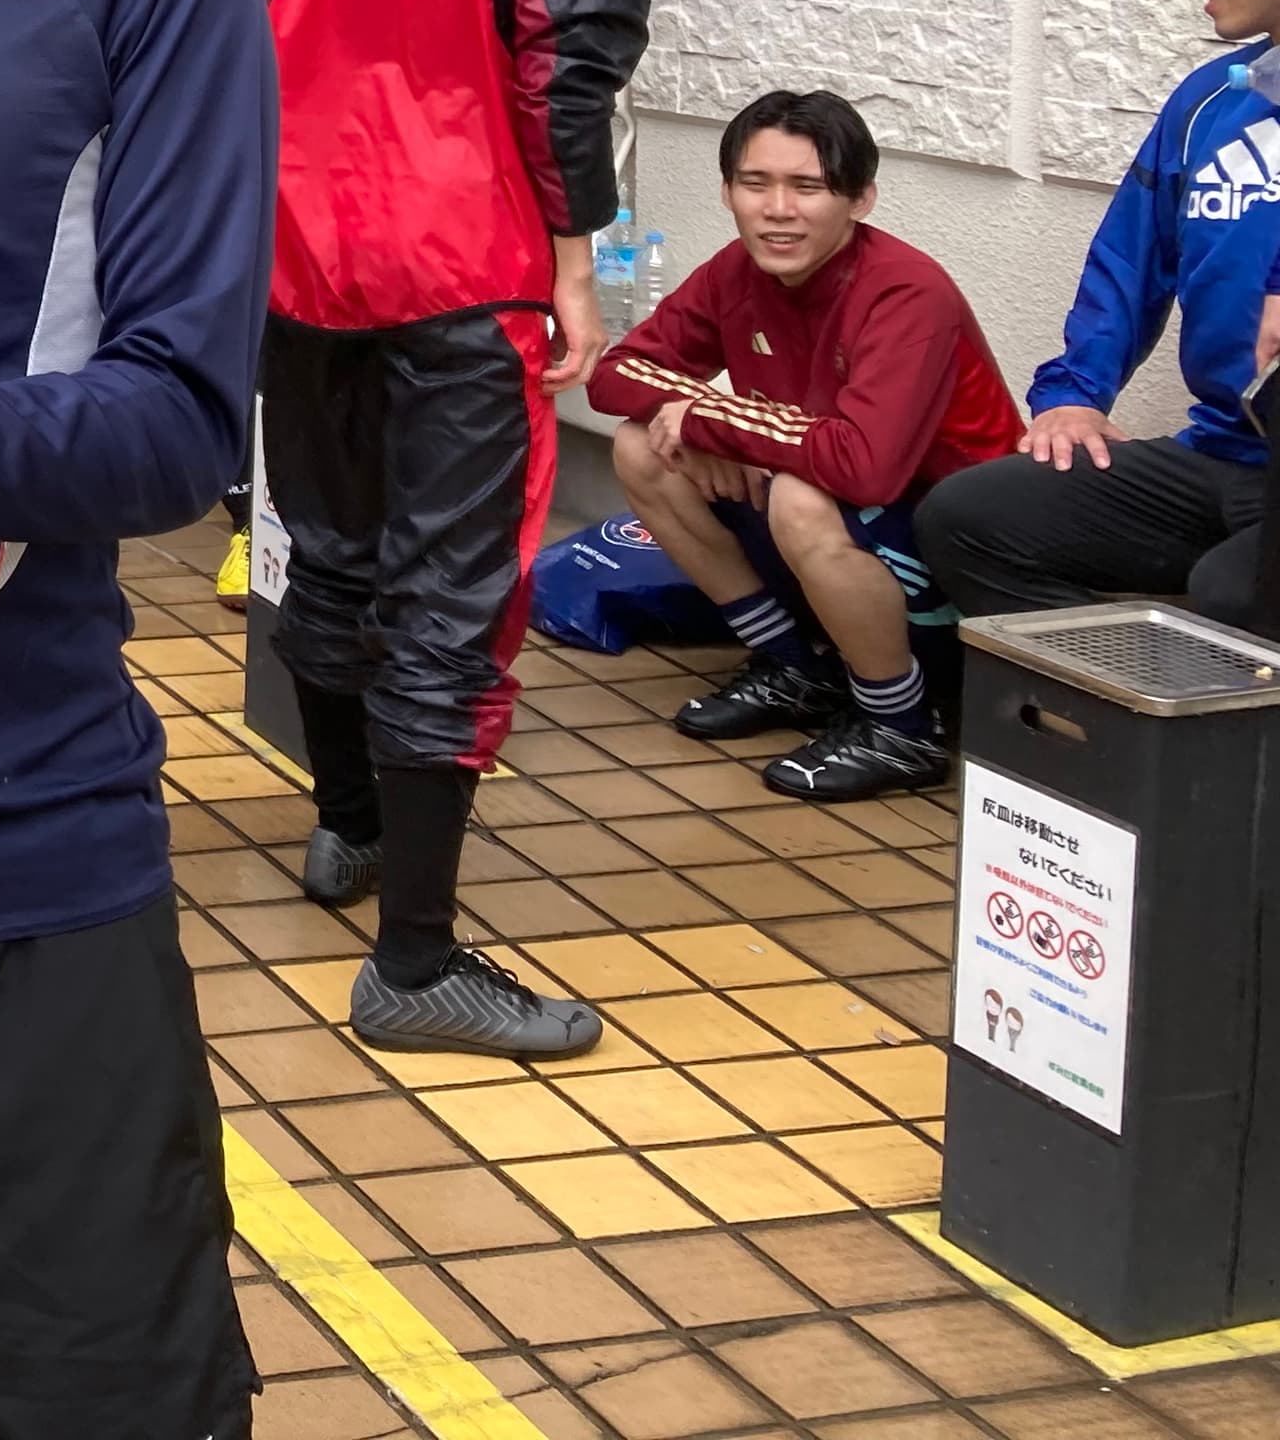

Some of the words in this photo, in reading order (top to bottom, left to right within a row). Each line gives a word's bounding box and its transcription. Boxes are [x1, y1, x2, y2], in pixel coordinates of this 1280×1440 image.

[982, 797, 1080, 855] 灰皿は移動させ
[1019, 847, 1112, 902] ないでください
